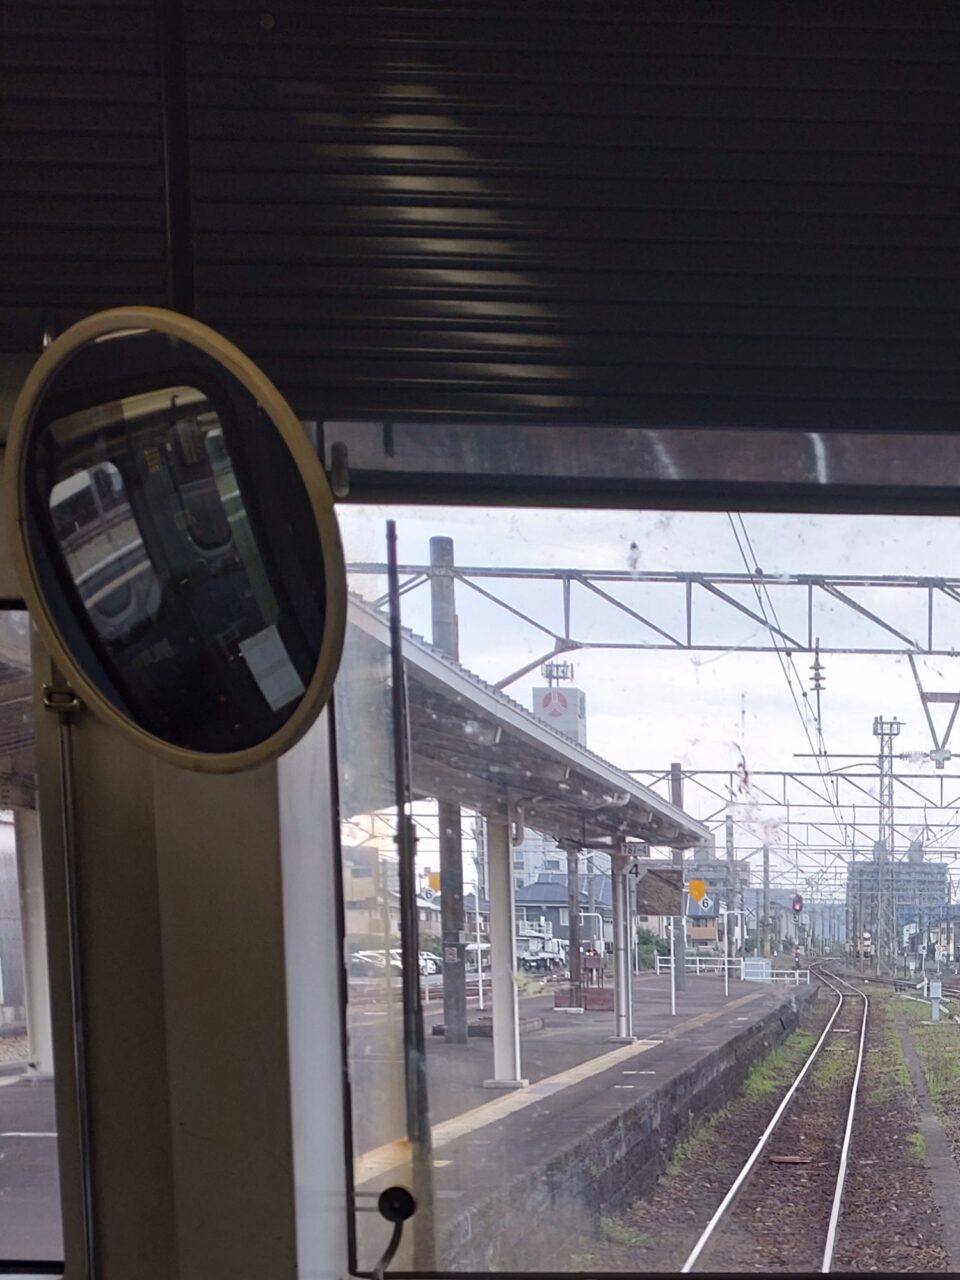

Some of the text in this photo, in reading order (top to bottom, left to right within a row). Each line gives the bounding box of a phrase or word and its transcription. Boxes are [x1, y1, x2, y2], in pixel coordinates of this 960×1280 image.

[628, 862, 641, 878] 4
[425, 889, 433, 901] 6
[702, 898, 710, 909] 6
